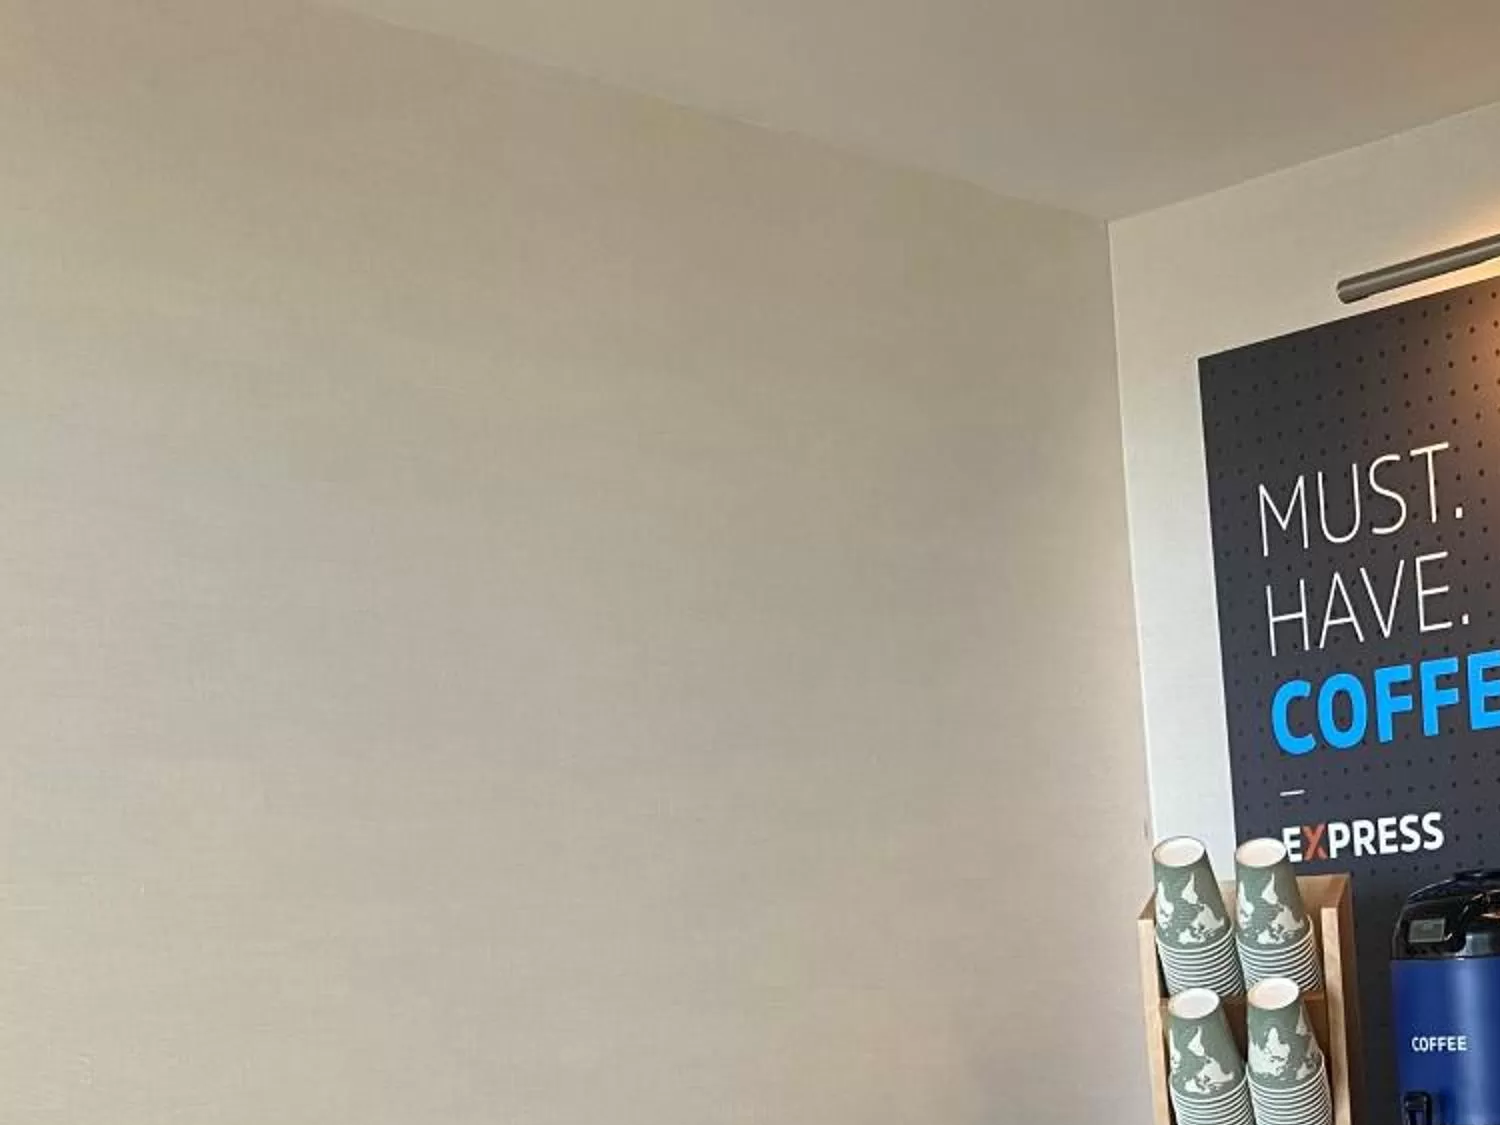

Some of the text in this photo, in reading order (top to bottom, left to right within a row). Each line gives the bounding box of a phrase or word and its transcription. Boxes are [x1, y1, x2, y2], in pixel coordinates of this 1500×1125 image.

[1258, 441, 1464, 557] MUST.
[1265, 551, 1470, 657] HAVE.
[1282, 812, 1445, 864] EXPRESS
[1411, 1035, 1469, 1052] COFFEE
